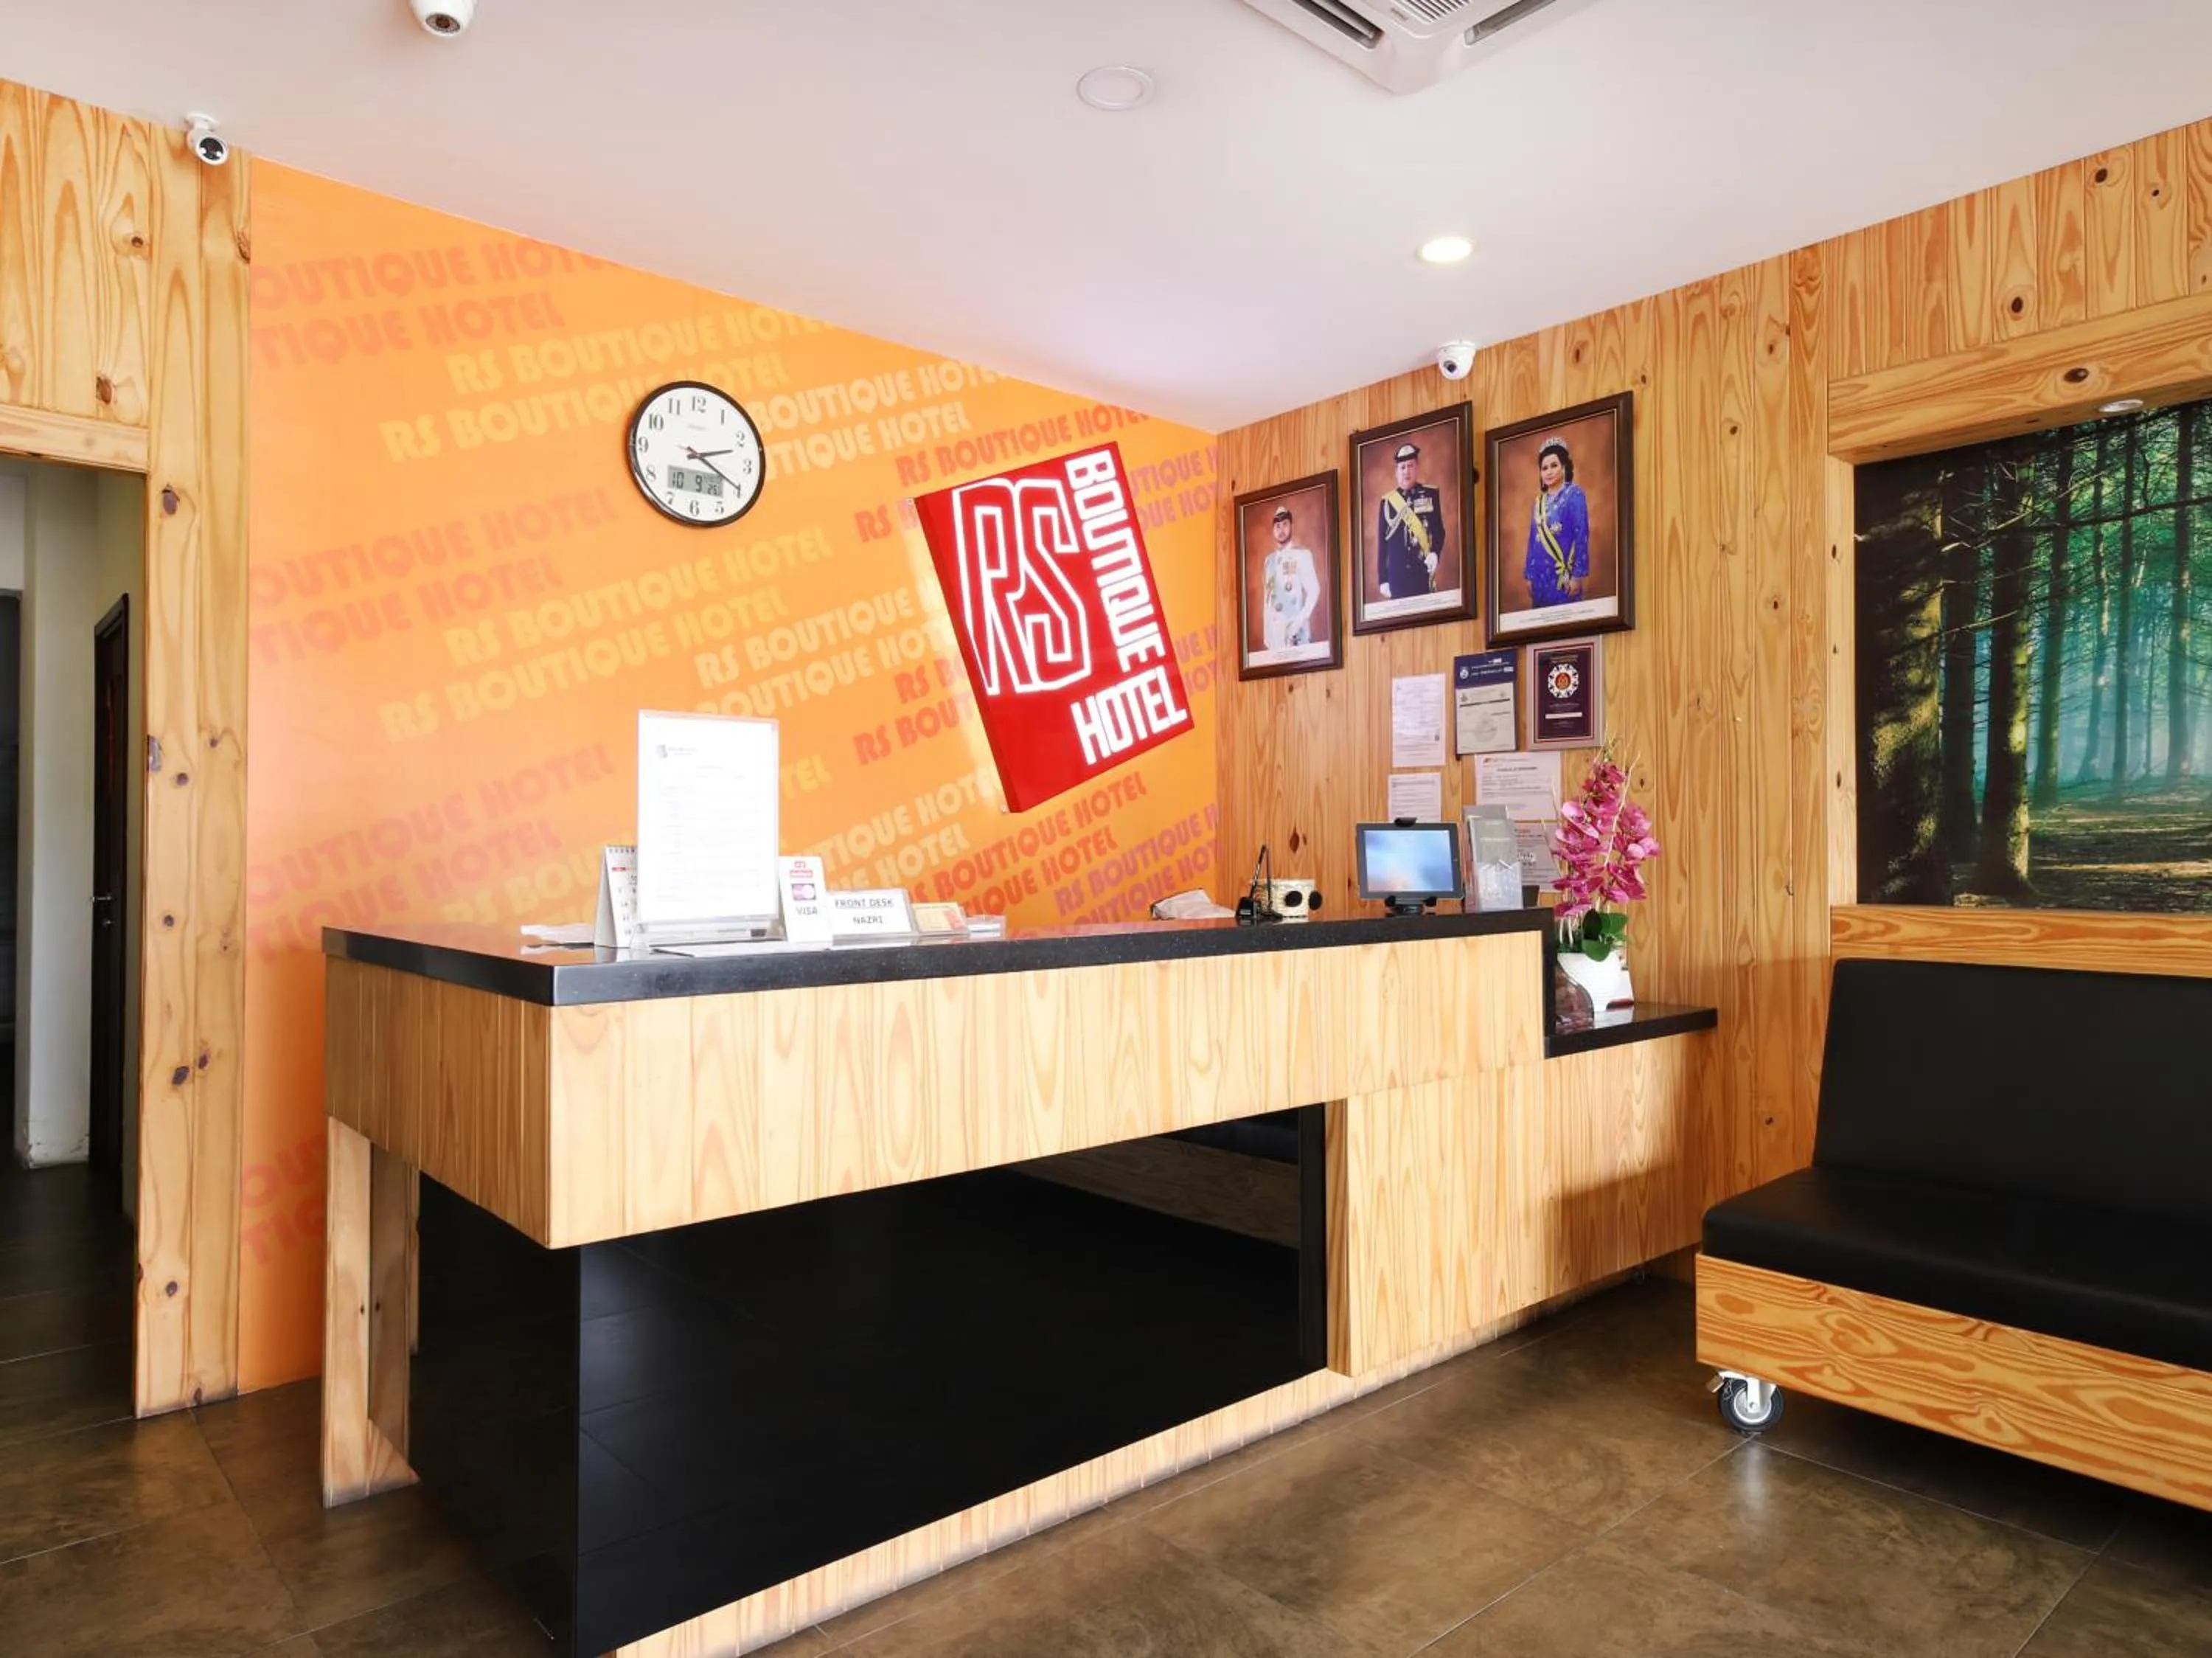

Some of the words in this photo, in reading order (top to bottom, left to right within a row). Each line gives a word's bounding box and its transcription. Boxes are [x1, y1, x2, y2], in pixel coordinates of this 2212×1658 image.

[481, 239, 618, 282] HOT
[418, 291, 566, 347] HOTEL
[445, 348, 503, 395] RS
[507, 314, 722, 383] BOUTIQUE
[723, 306, 835, 347] HOT
[692, 396, 707, 413] 12
[917, 361, 1010, 398] HOT
[648, 414, 664, 431] 10
[668, 398, 681, 415] 11
[720, 409, 726, 426] 1
[877, 401, 972, 451] HOTEL
[378, 414, 441, 463] RS
[638, 437, 649, 453] 9
[736, 430, 745, 448] 2
[894, 450, 931, 488] RS
[935, 414, 1072, 476] BOUTIQUE
[1074, 403, 1149, 437] HOTE
[646, 465, 657, 482] 8
[743, 459, 752, 474] 3
[479, 485, 619, 552] HOTEL
[689, 500, 700, 516] 6
[714, 501, 724, 514] 5
[853, 503, 892, 544] RS
[1065, 449, 1166, 672] BOUTIQUE
[417, 553, 563, 622] HOTEL
[444, 618, 502, 667] RS
[506, 558, 722, 649] BOUTIQUE
[723, 526, 834, 586] HOTEL
[952, 478, 1091, 695] RS
[695, 644, 740, 689] RS
[744, 586, 915, 672] BOUTIQUE
[378, 691, 440, 745] RS
[445, 621, 672, 723] BOUTIQUE
[672, 586, 790, 650] HOTEL
[893, 664, 930, 704] RS
[1070, 665, 1188, 766] HOTEL
[852, 724, 892, 766] RS
[478, 740, 618, 821] HOTEL
[412, 816, 563, 900] HOTEL
[875, 822, 970, 888] HOTEL
[933, 808, 1071, 902] BOUTIQUE
[1071, 771, 1148, 829] HOTEL
[1040, 825, 1119, 886] HOTEL
[1054, 878, 1085, 918] RS
[1088, 811, 1203, 898] BOUTIQUE
[796, 906, 818, 915] VISA
